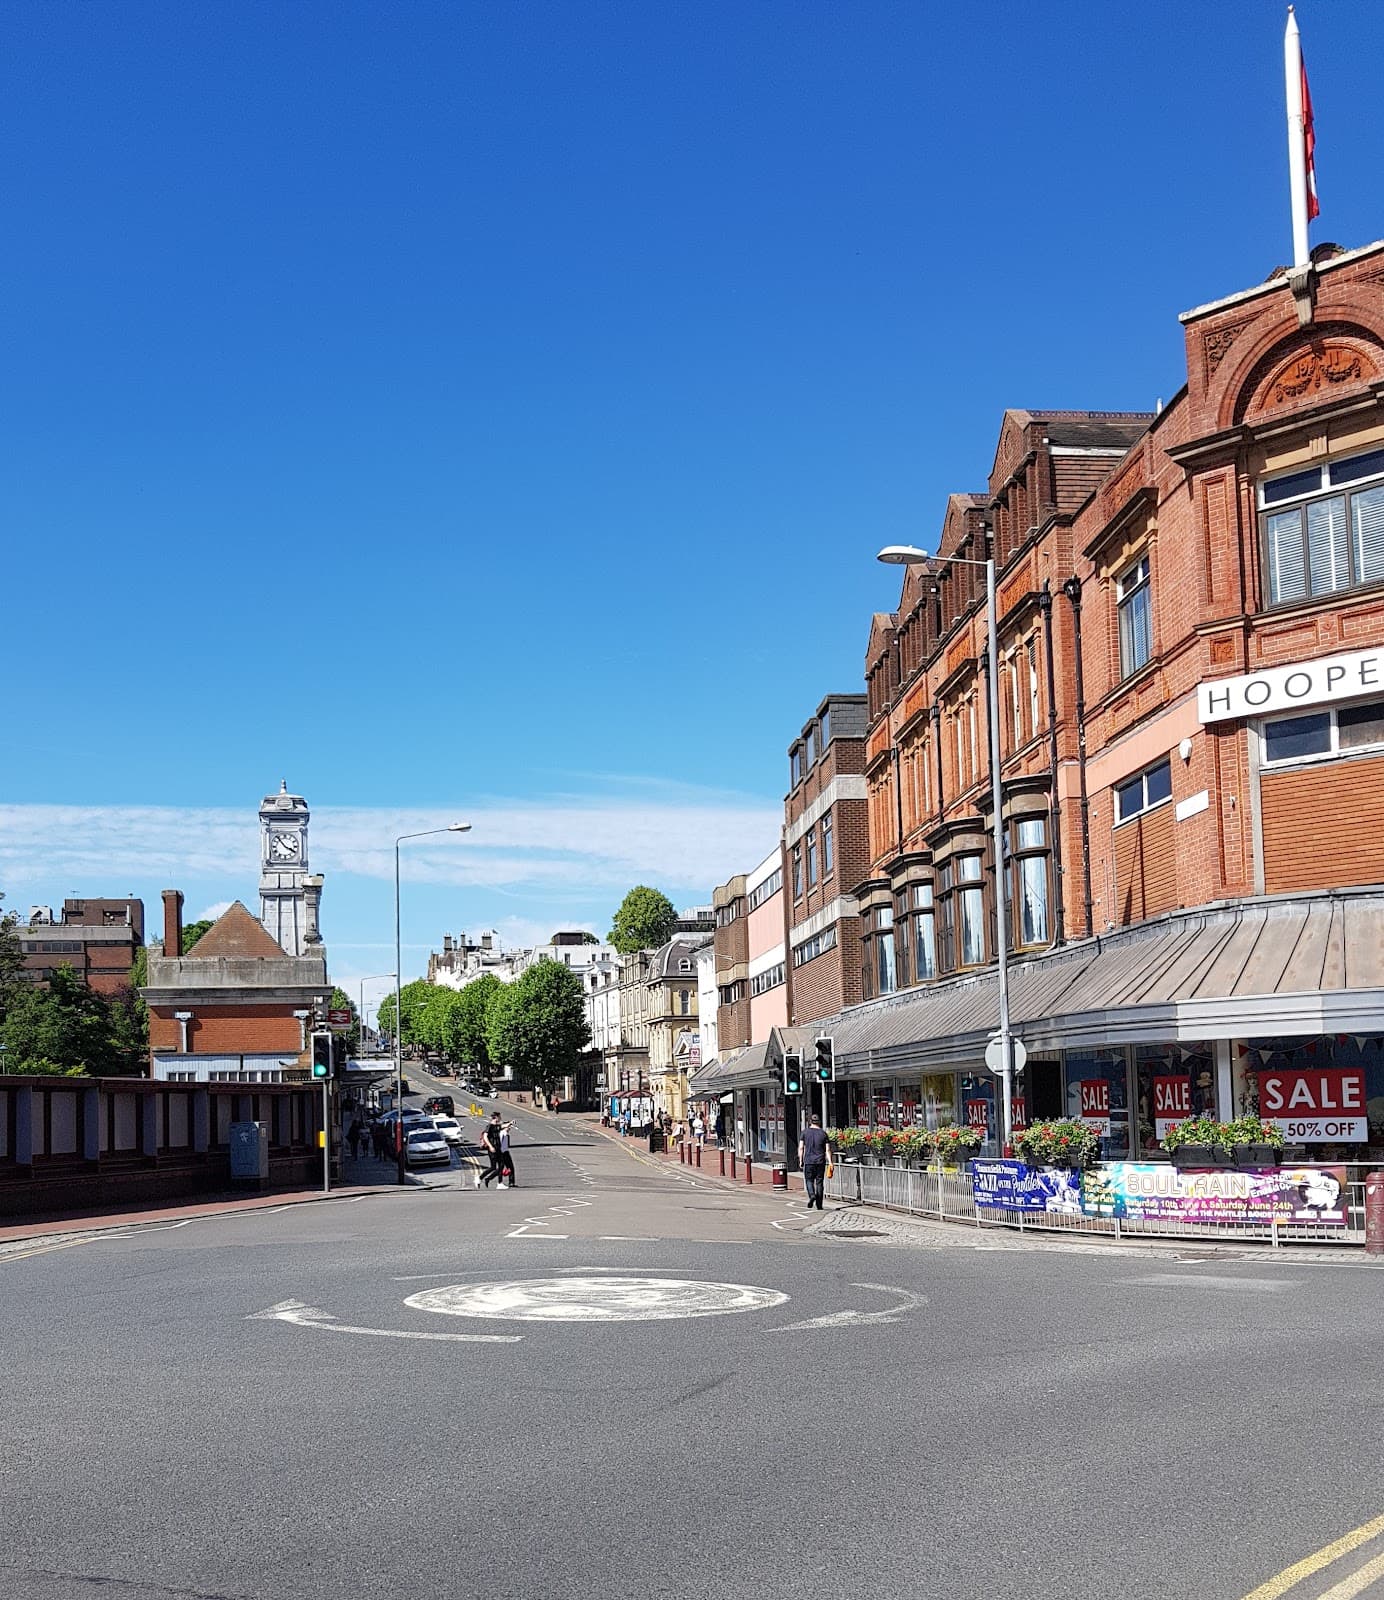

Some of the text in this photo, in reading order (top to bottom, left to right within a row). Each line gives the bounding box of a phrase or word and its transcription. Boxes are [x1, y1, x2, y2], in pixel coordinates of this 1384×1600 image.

[1208, 657, 1379, 714] HOOPE
[1082, 1086, 1109, 1111] SALE
[1156, 1082, 1190, 1111] SALE
[1265, 1077, 1361, 1110] SALE
[968, 1104, 987, 1125] SALE
[1288, 1122, 1322, 1137] 50%
[1125, 1198, 1159, 1208] Saturday
[1161, 1199, 1178, 1209] 10th
[1179, 1200, 1200, 1209] June
[1209, 1201, 1247, 1211] Saturday
[1249, 1201, 1271, 1210] June
[1273, 1201, 1294, 1210] 24th
